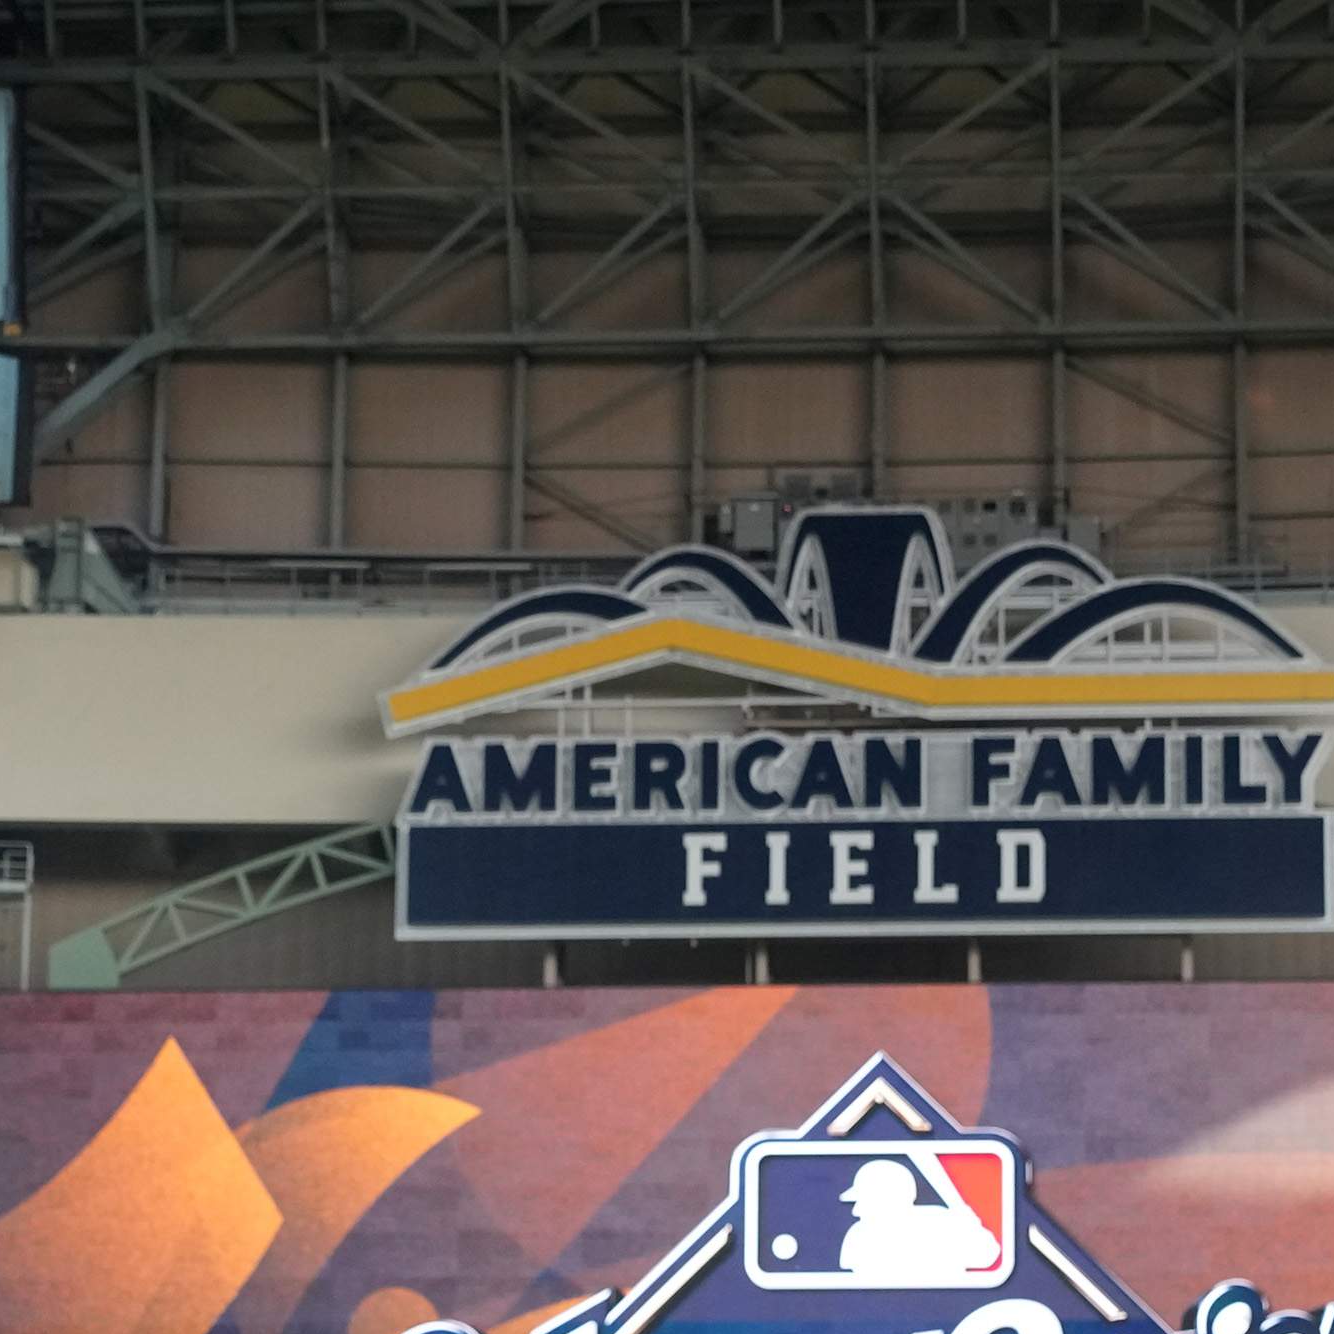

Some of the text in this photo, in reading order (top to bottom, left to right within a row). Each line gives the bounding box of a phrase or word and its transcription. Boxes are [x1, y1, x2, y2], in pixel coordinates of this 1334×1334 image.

[410, 731, 1325, 816] AMERICAN FAMILY
[682, 829, 1047, 907] FIELD
